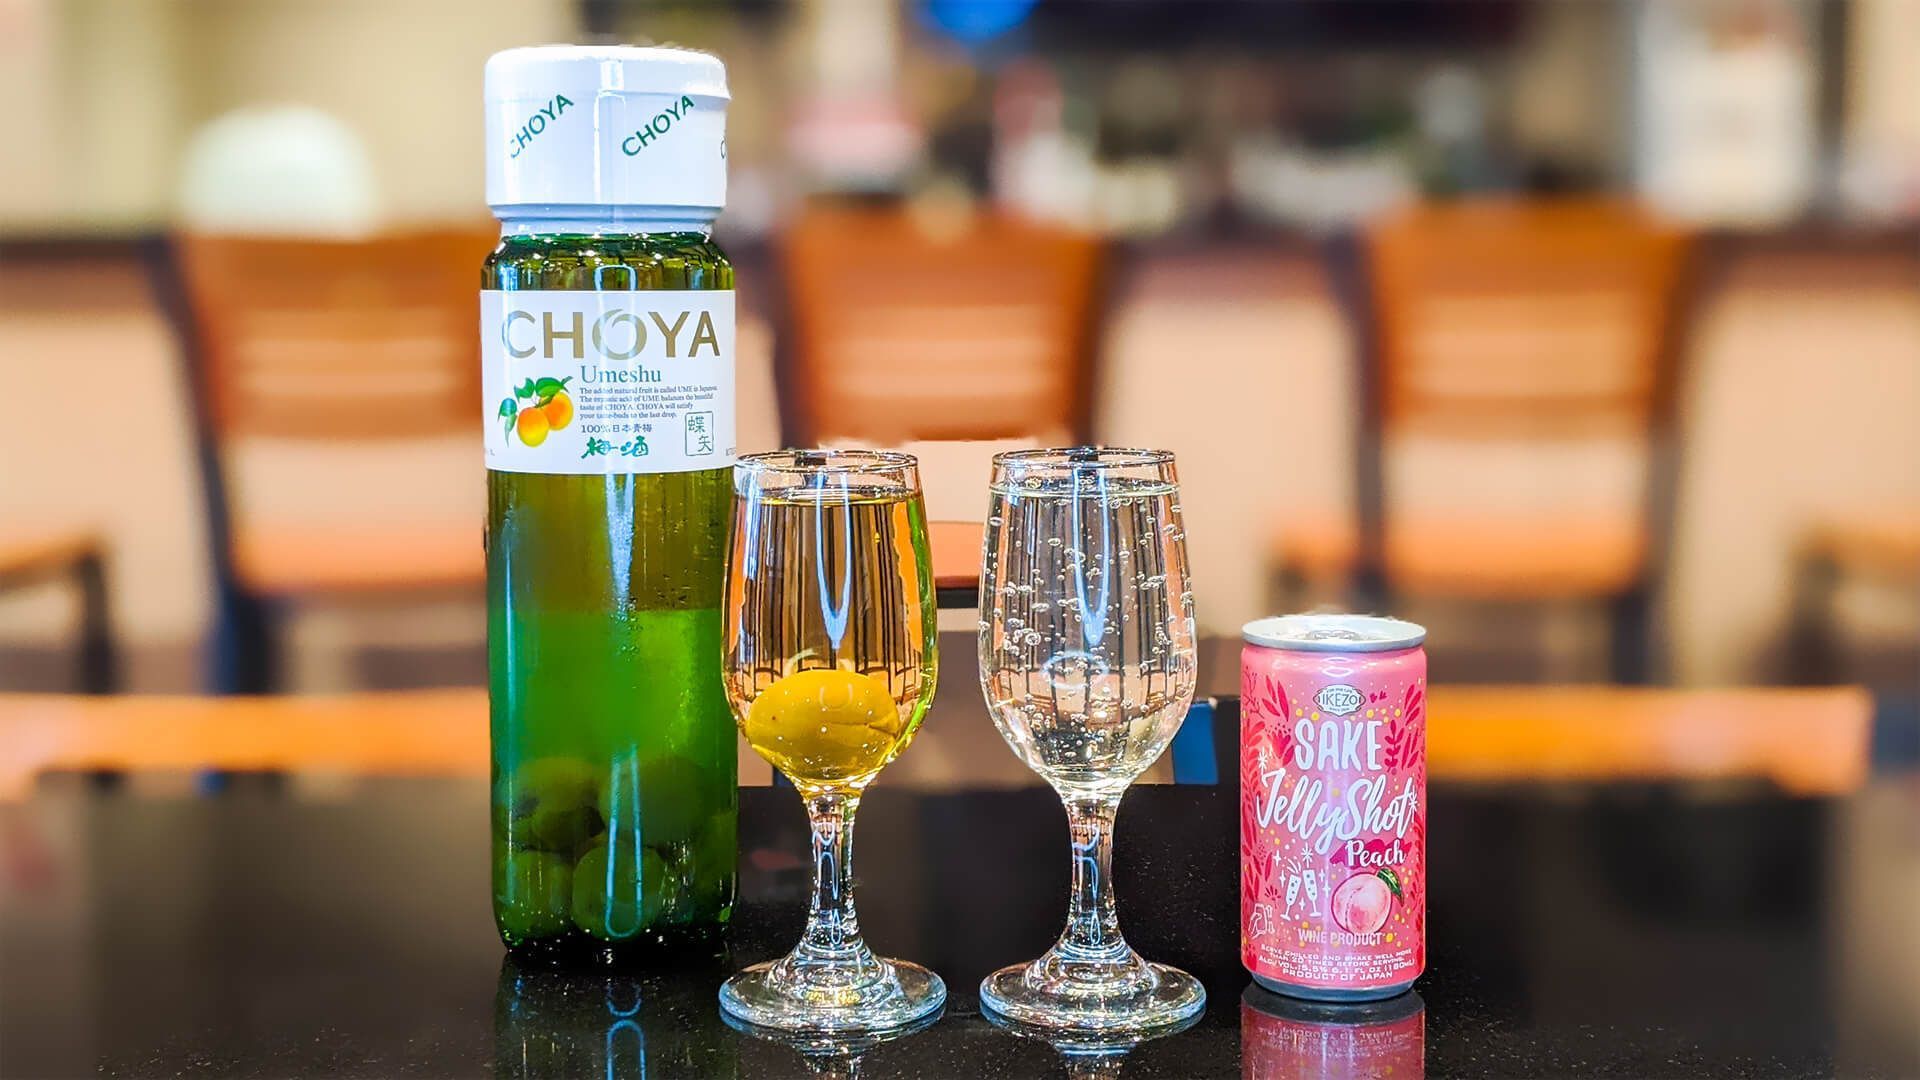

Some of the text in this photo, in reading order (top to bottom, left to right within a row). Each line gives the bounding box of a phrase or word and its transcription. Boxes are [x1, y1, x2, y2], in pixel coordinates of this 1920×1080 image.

[621, 95, 695, 157] CHOYA
[501, 308, 721, 361] CHOYA
[580, 364, 662, 384] Umeshu
[593, 386, 613, 394] add
[638, 386, 653, 394] fruit
[660, 385, 677, 393] called
[641, 394, 660, 402] UME
[636, 402, 664, 410] CHOYA
[1322, 692, 1358, 707] IKEZO
[1294, 718, 1383, 772] SAKE
[1345, 838, 1406, 867] Peach
[1298, 927, 1383, 947] WINE PRODUCT
[1284, 949, 1320, 961] CHILLED
[1322, 954, 1342, 962] AND
[1282, 968, 1393, 981] PRODUCT OF JAPAN
